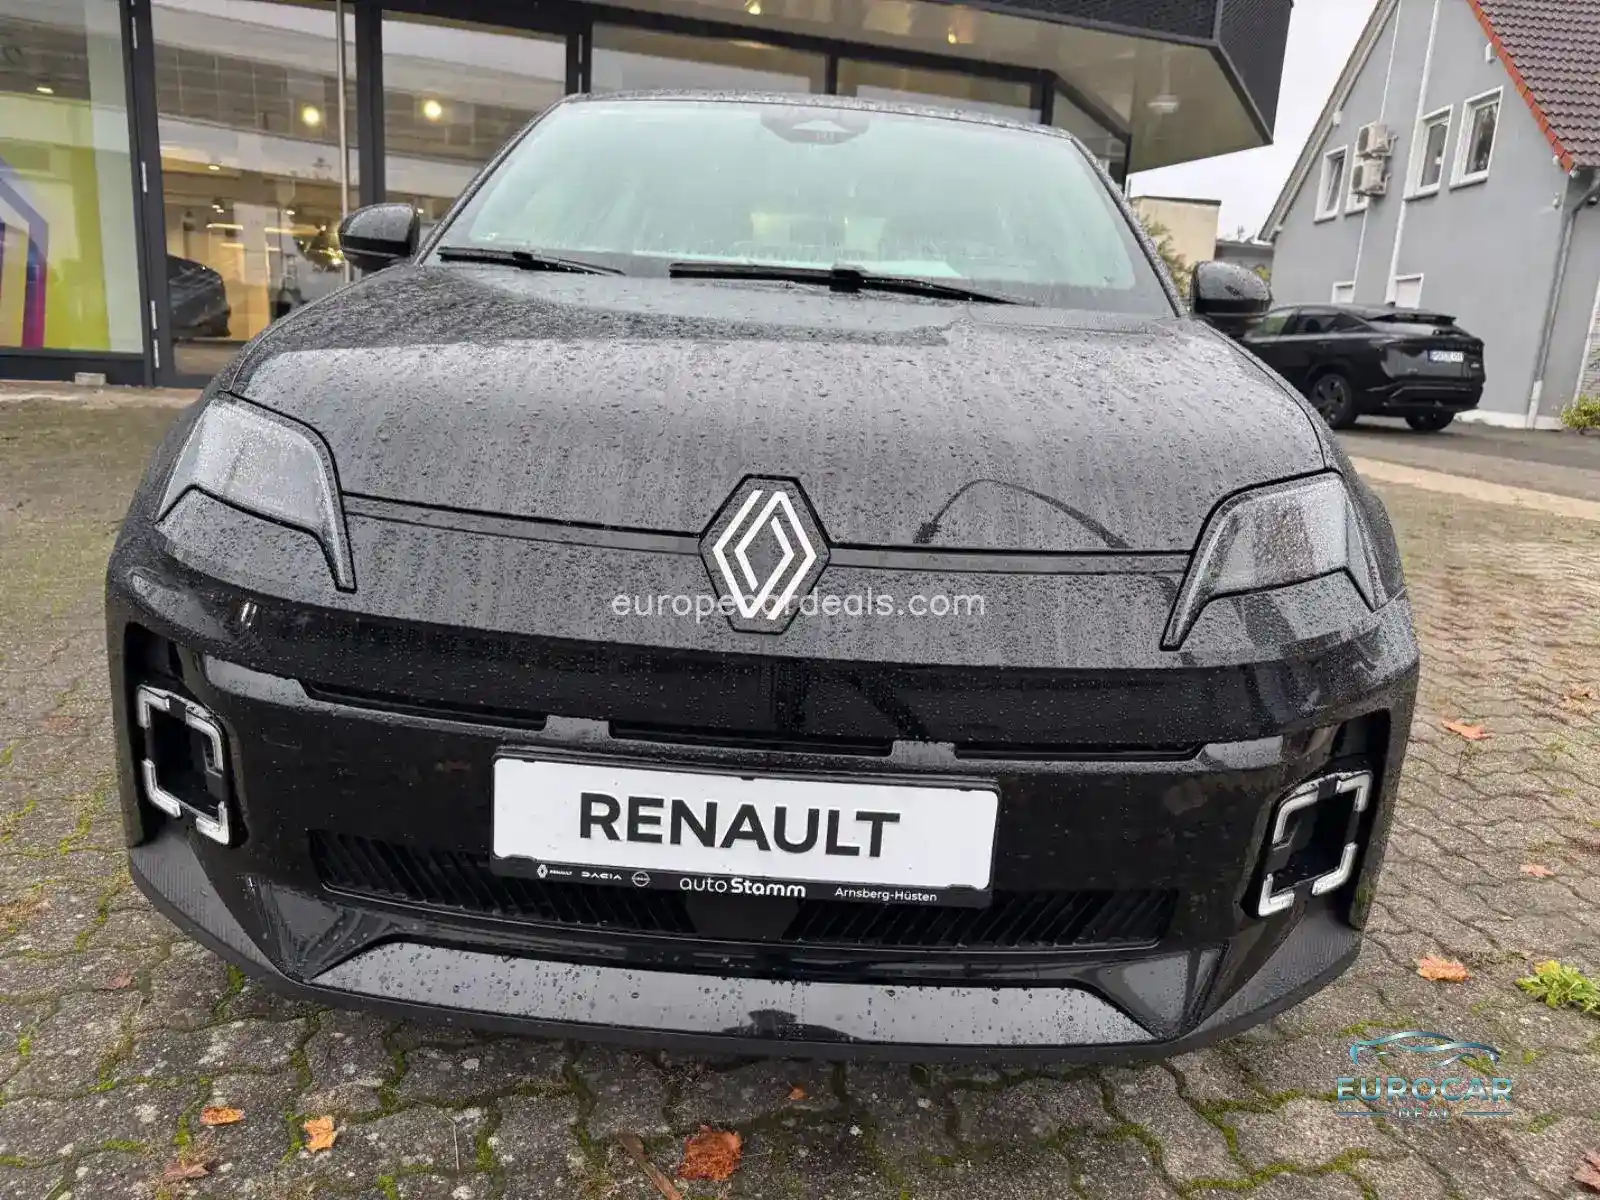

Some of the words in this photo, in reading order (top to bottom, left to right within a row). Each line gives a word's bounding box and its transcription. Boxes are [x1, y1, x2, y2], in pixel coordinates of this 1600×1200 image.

[579, 792, 901, 858] RENAULT
[581, 871, 623, 881] DACIA
[834, 886, 938, 903] Arnsberg-Hüsten
